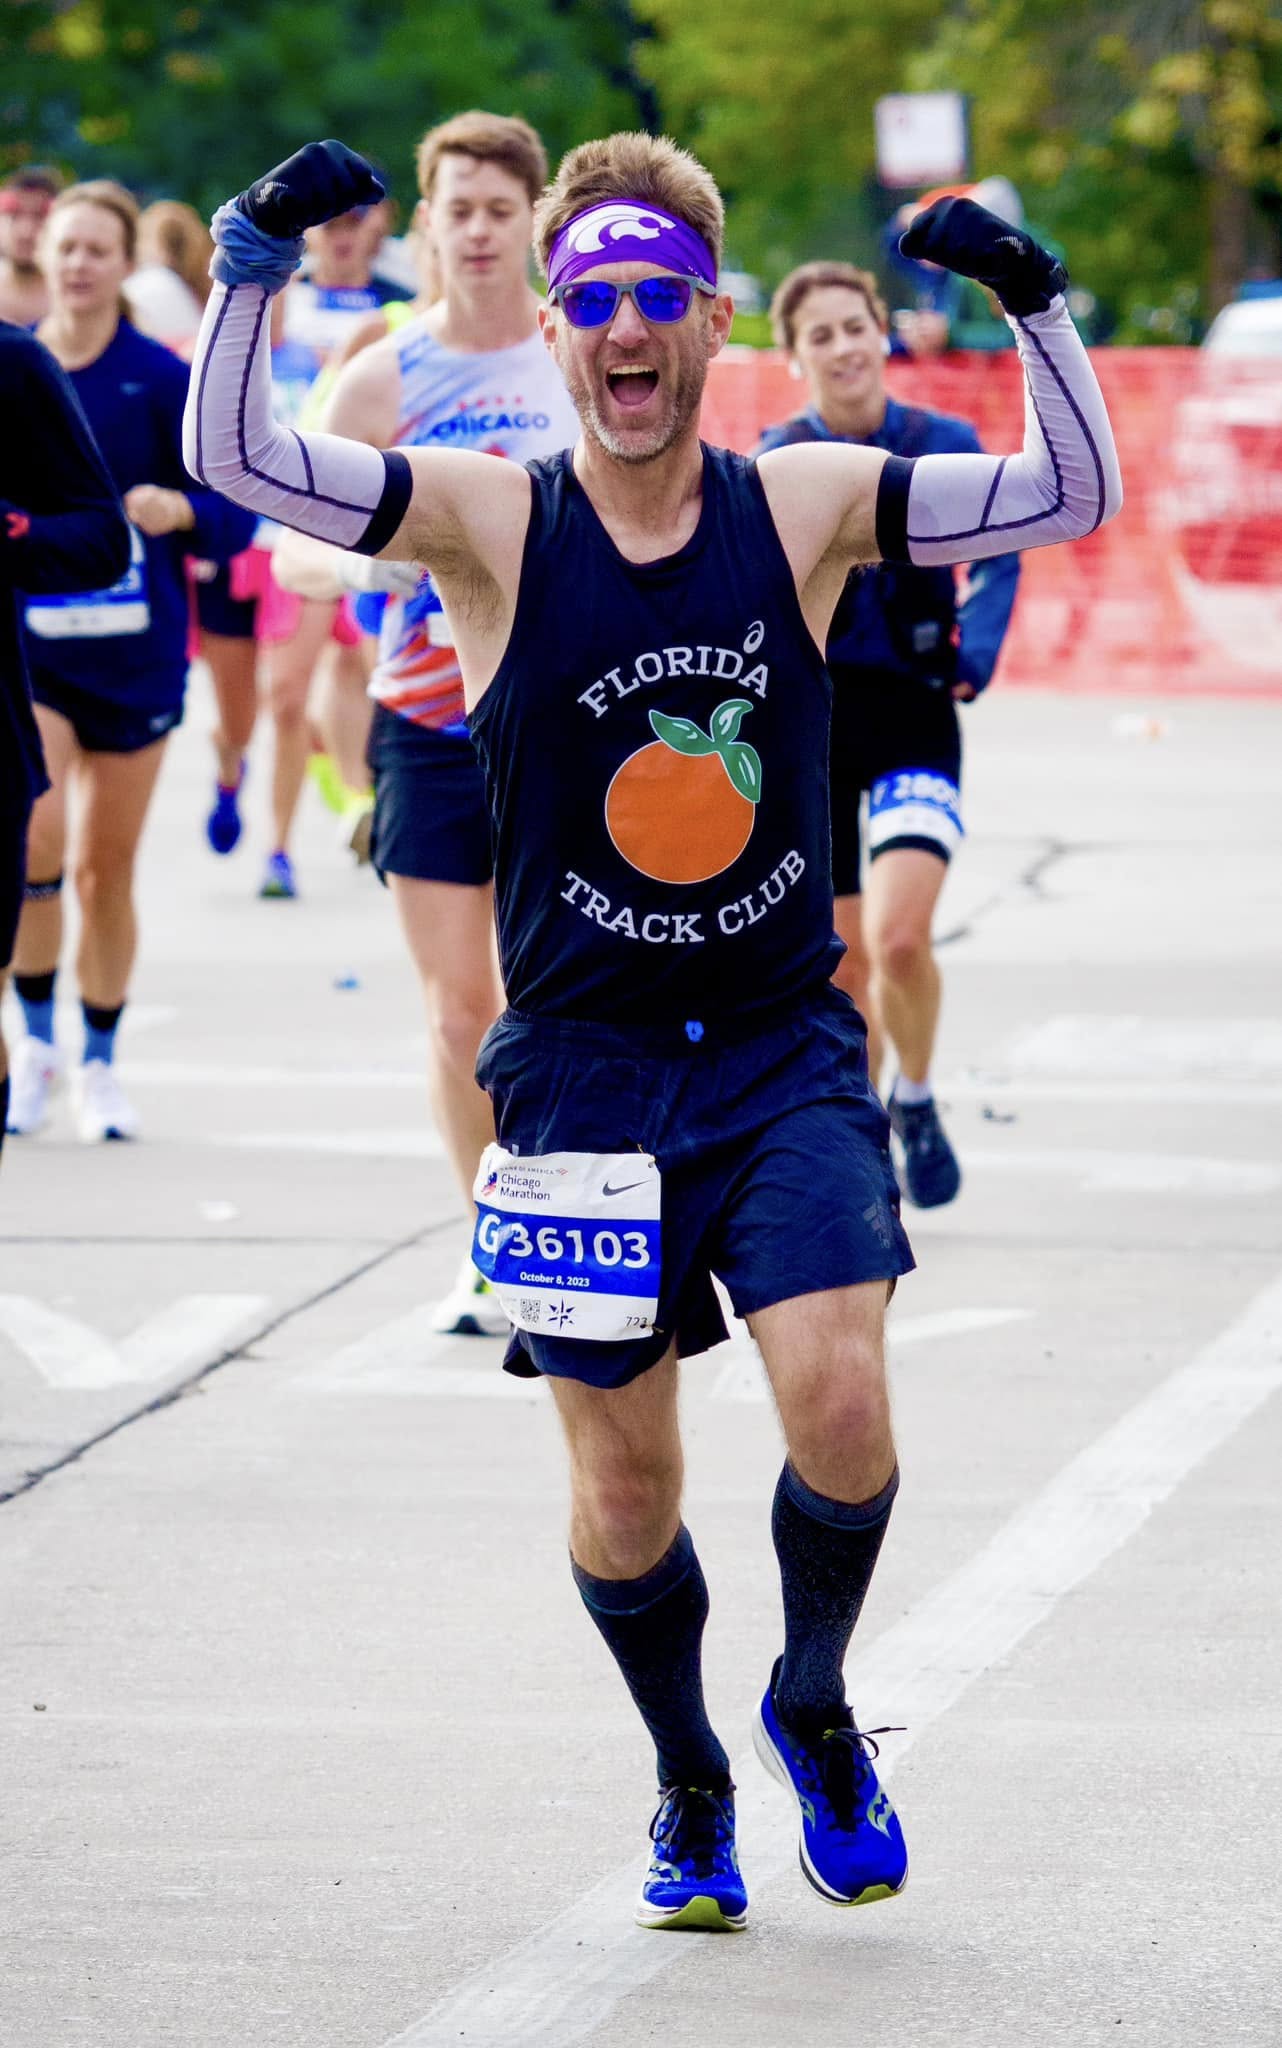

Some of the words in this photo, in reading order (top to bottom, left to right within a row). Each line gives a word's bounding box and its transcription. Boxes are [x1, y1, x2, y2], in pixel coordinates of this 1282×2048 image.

[577, 646, 769, 718] FLORIDA
[560, 870, 705, 944] TRACK
[717, 849, 806, 935] CLUB
[501, 1173, 541, 1190] Chicago
[500, 1186, 551, 1200] Marathon
[519, 1271, 555, 1284] October
[555, 1275, 565, 1286] 8,
[566, 1276, 590, 1287] 2023
